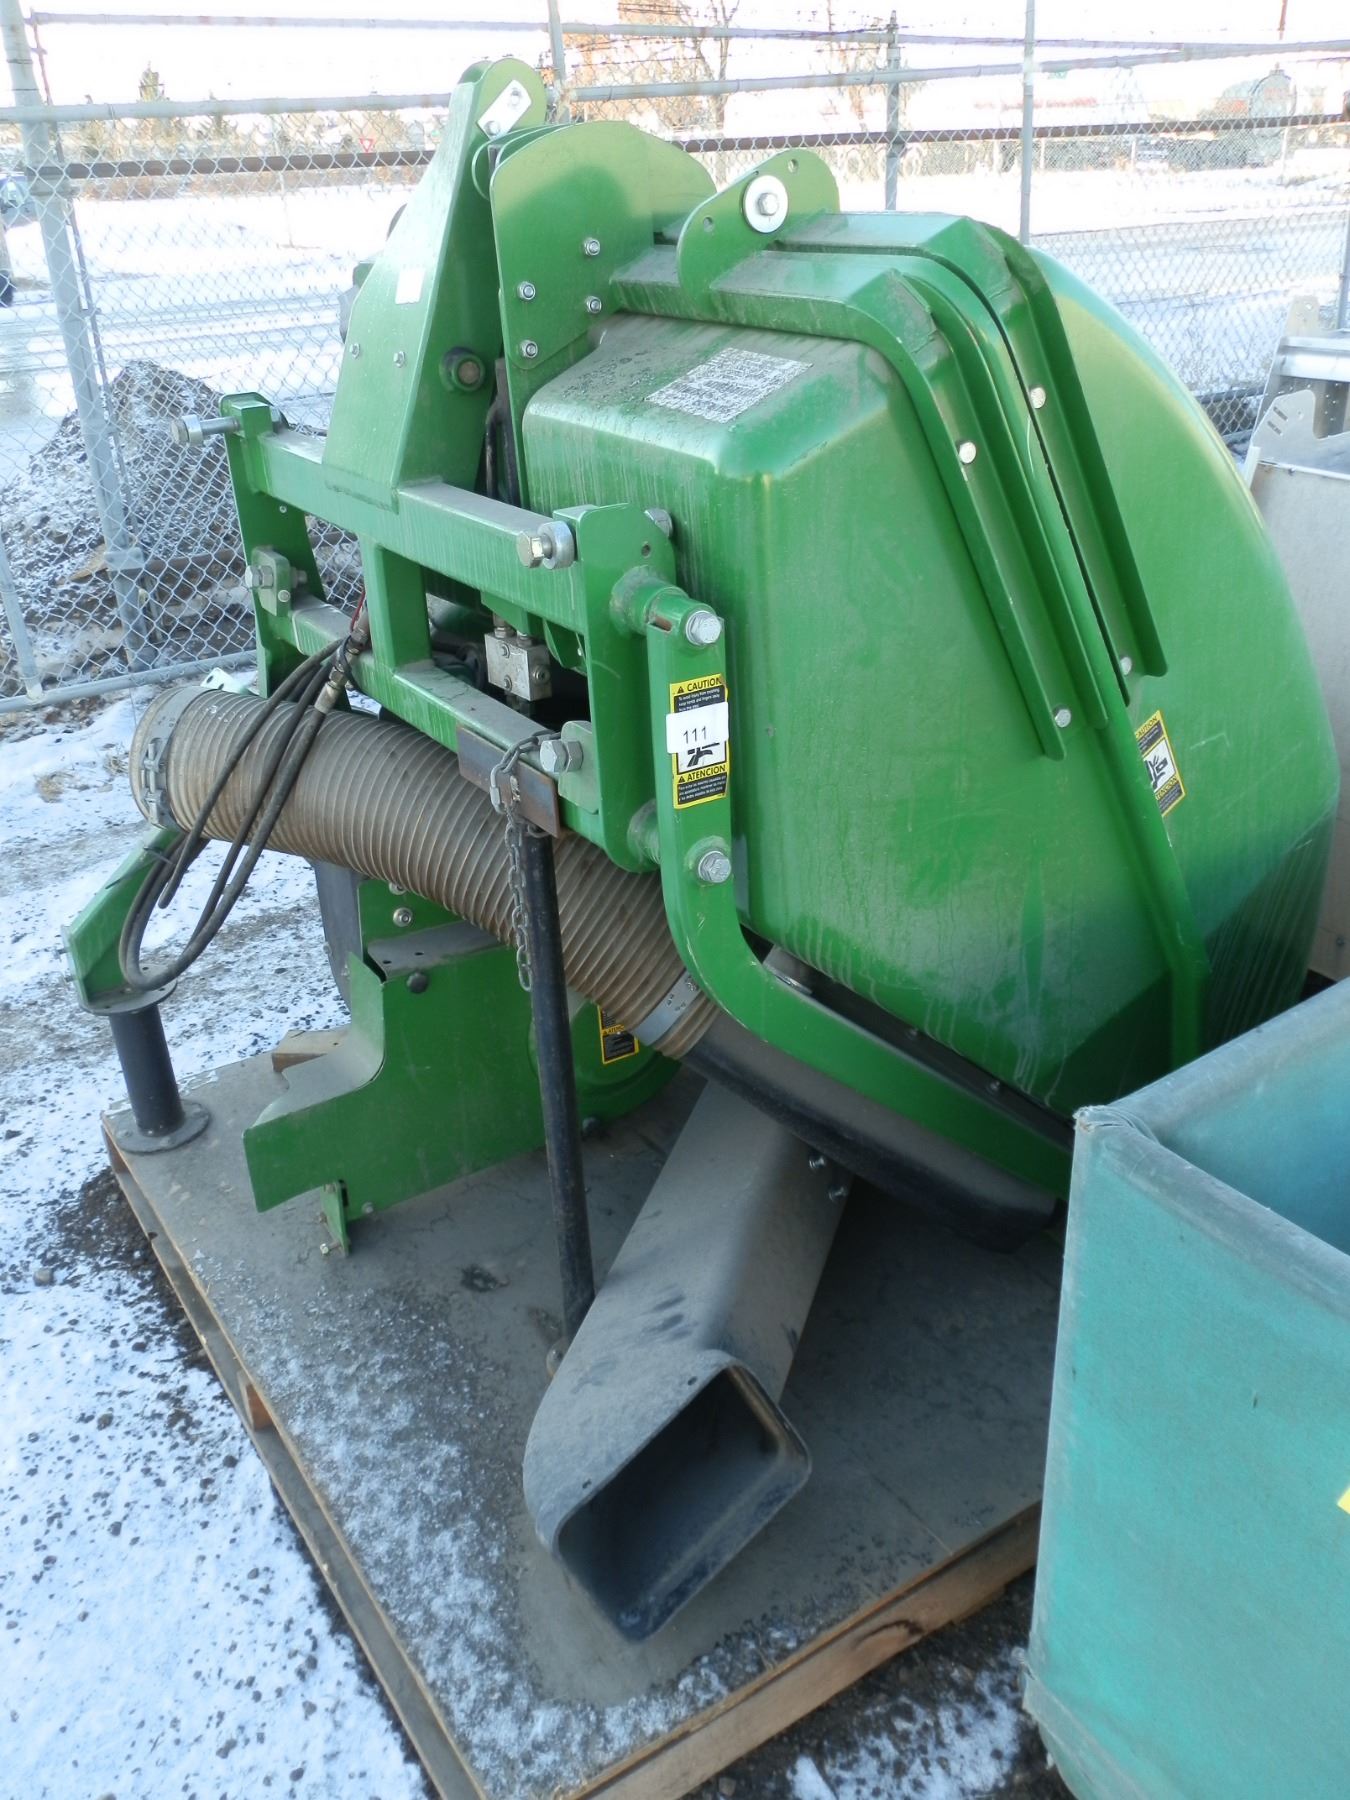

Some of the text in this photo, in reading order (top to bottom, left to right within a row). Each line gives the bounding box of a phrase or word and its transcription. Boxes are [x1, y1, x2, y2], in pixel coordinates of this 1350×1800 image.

[687, 677, 722, 692] CAUTION
[683, 726, 706, 744] 111
[687, 764, 726, 781] ATENCION
